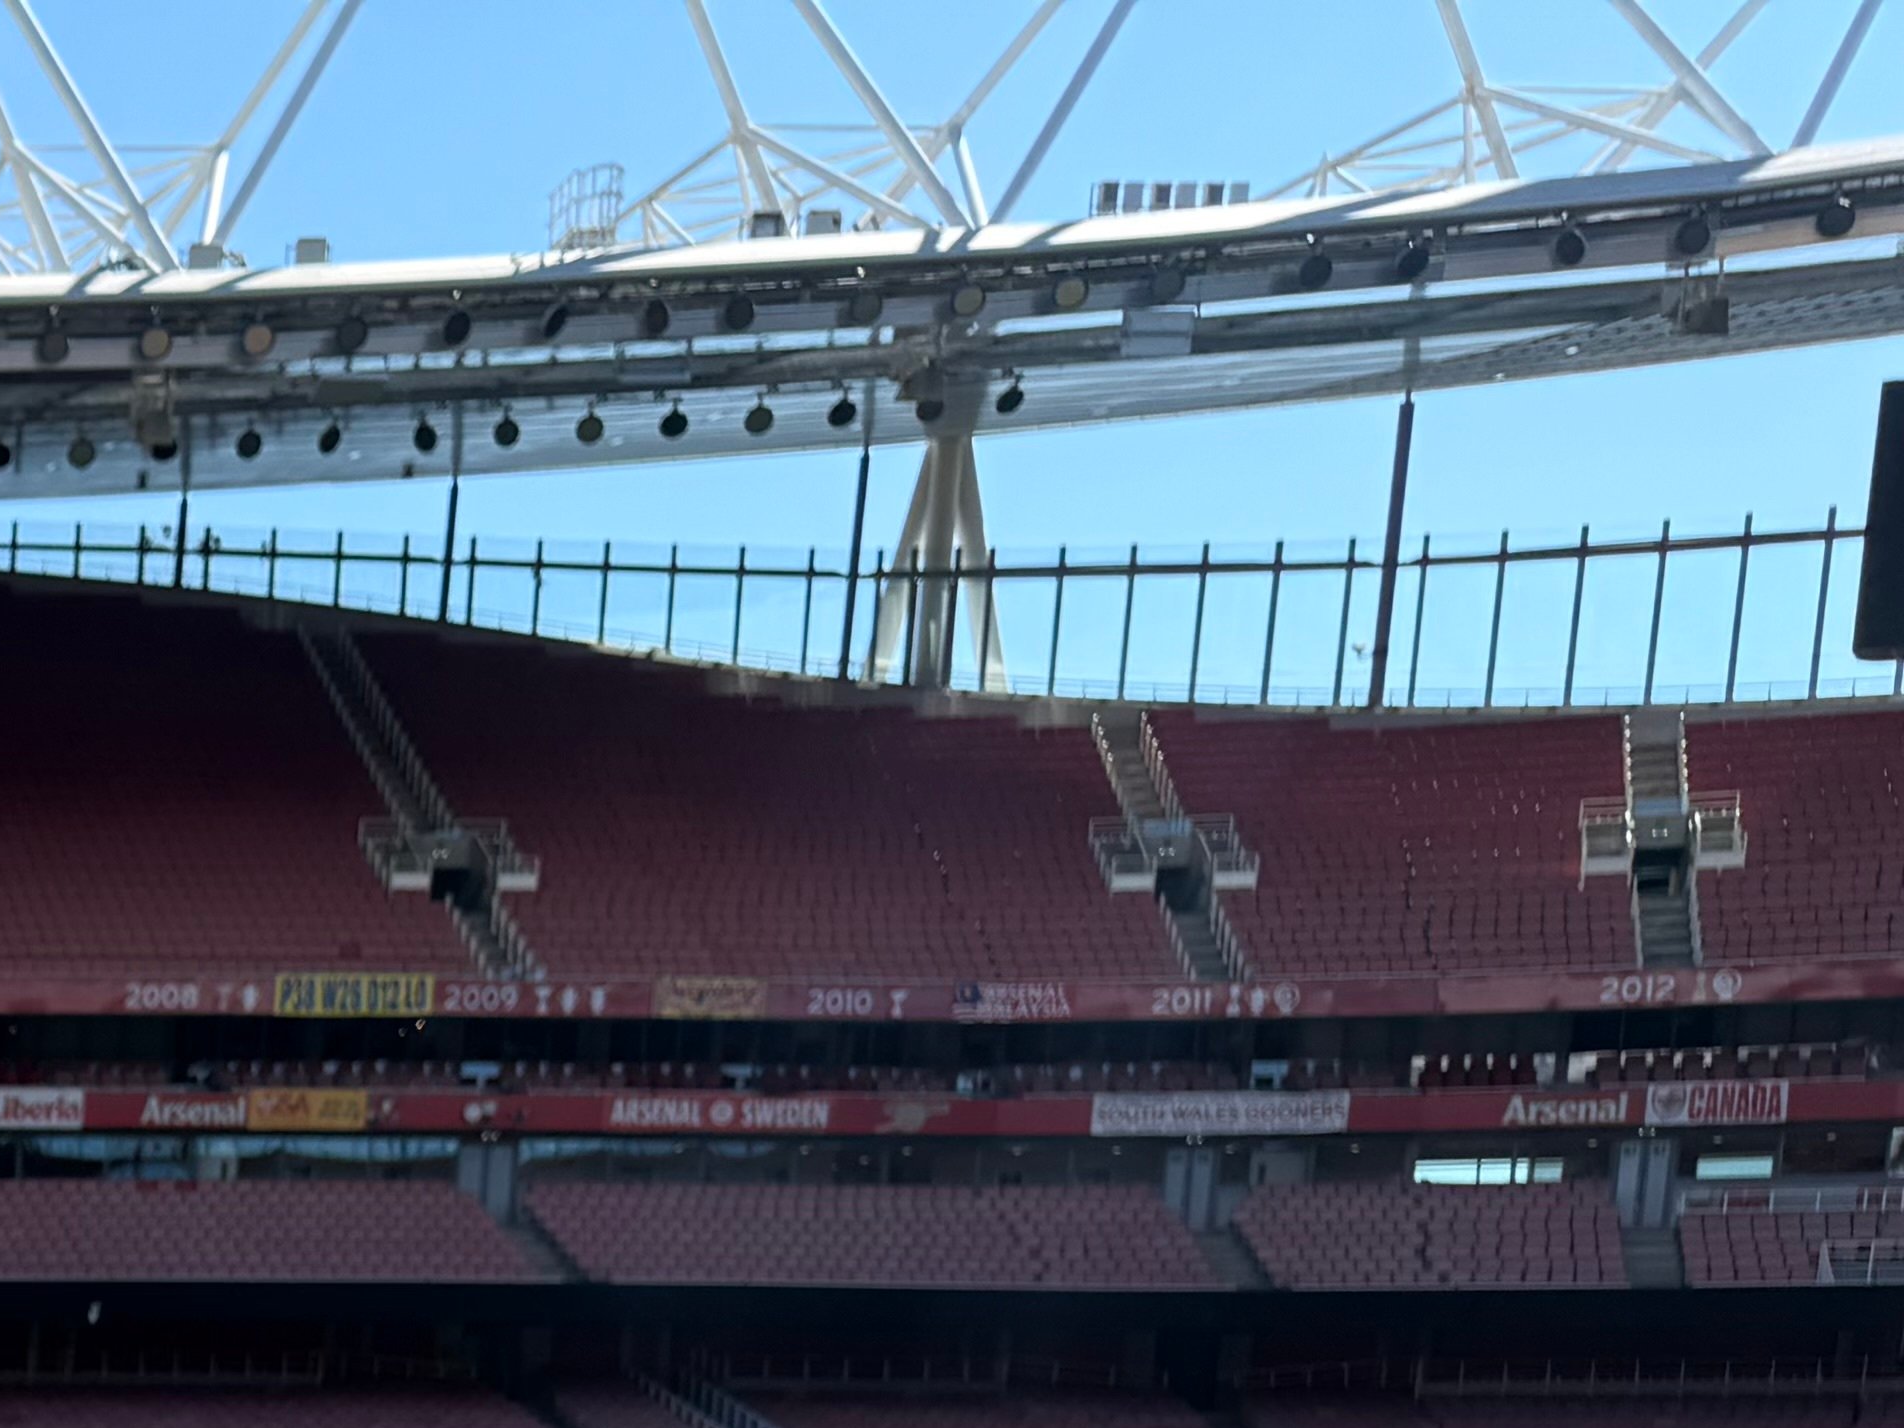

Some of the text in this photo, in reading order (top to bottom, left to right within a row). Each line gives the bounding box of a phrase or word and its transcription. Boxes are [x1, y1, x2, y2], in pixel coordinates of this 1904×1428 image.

[125, 982, 199, 1009] 2008
[444, 985, 519, 1012] 2009
[807, 988, 873, 1015] 2010
[1152, 986, 1212, 1014] 2011
[1600, 976, 1676, 1002] 2012
[140, 1096, 247, 1126] Arsenal
[610, 1099, 829, 1128] ARSENAL SWEDEN
[1171, 1104, 1239, 1121] WALES
[1244, 1102, 1346, 1121] GOONERS
[1502, 1091, 1629, 1125] Arsenal
[1688, 1085, 1782, 1120] CANADA
